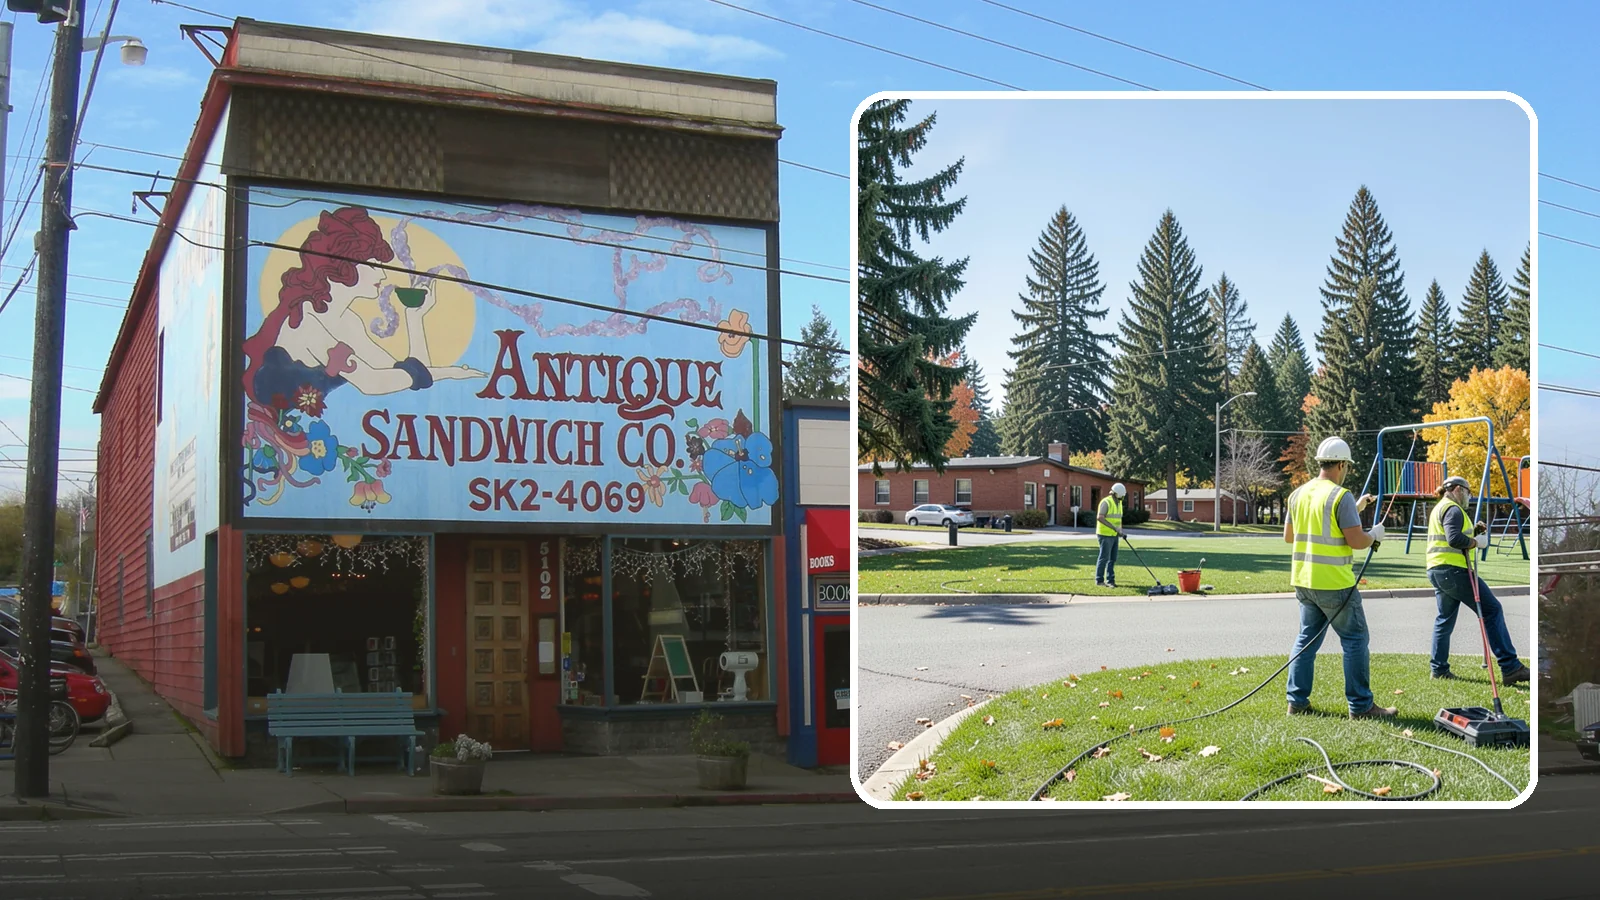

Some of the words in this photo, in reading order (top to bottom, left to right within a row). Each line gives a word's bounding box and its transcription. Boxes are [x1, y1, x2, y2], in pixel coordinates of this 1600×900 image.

[475, 329, 723, 420] ANTIQUE
[361, 409, 604, 467] SANDWICH
[617, 421, 684, 469] CO.
[468, 477, 646, 513] SK2-4069
[539, 541, 552, 600] 5102
[809, 555, 834, 569] BOOKS
